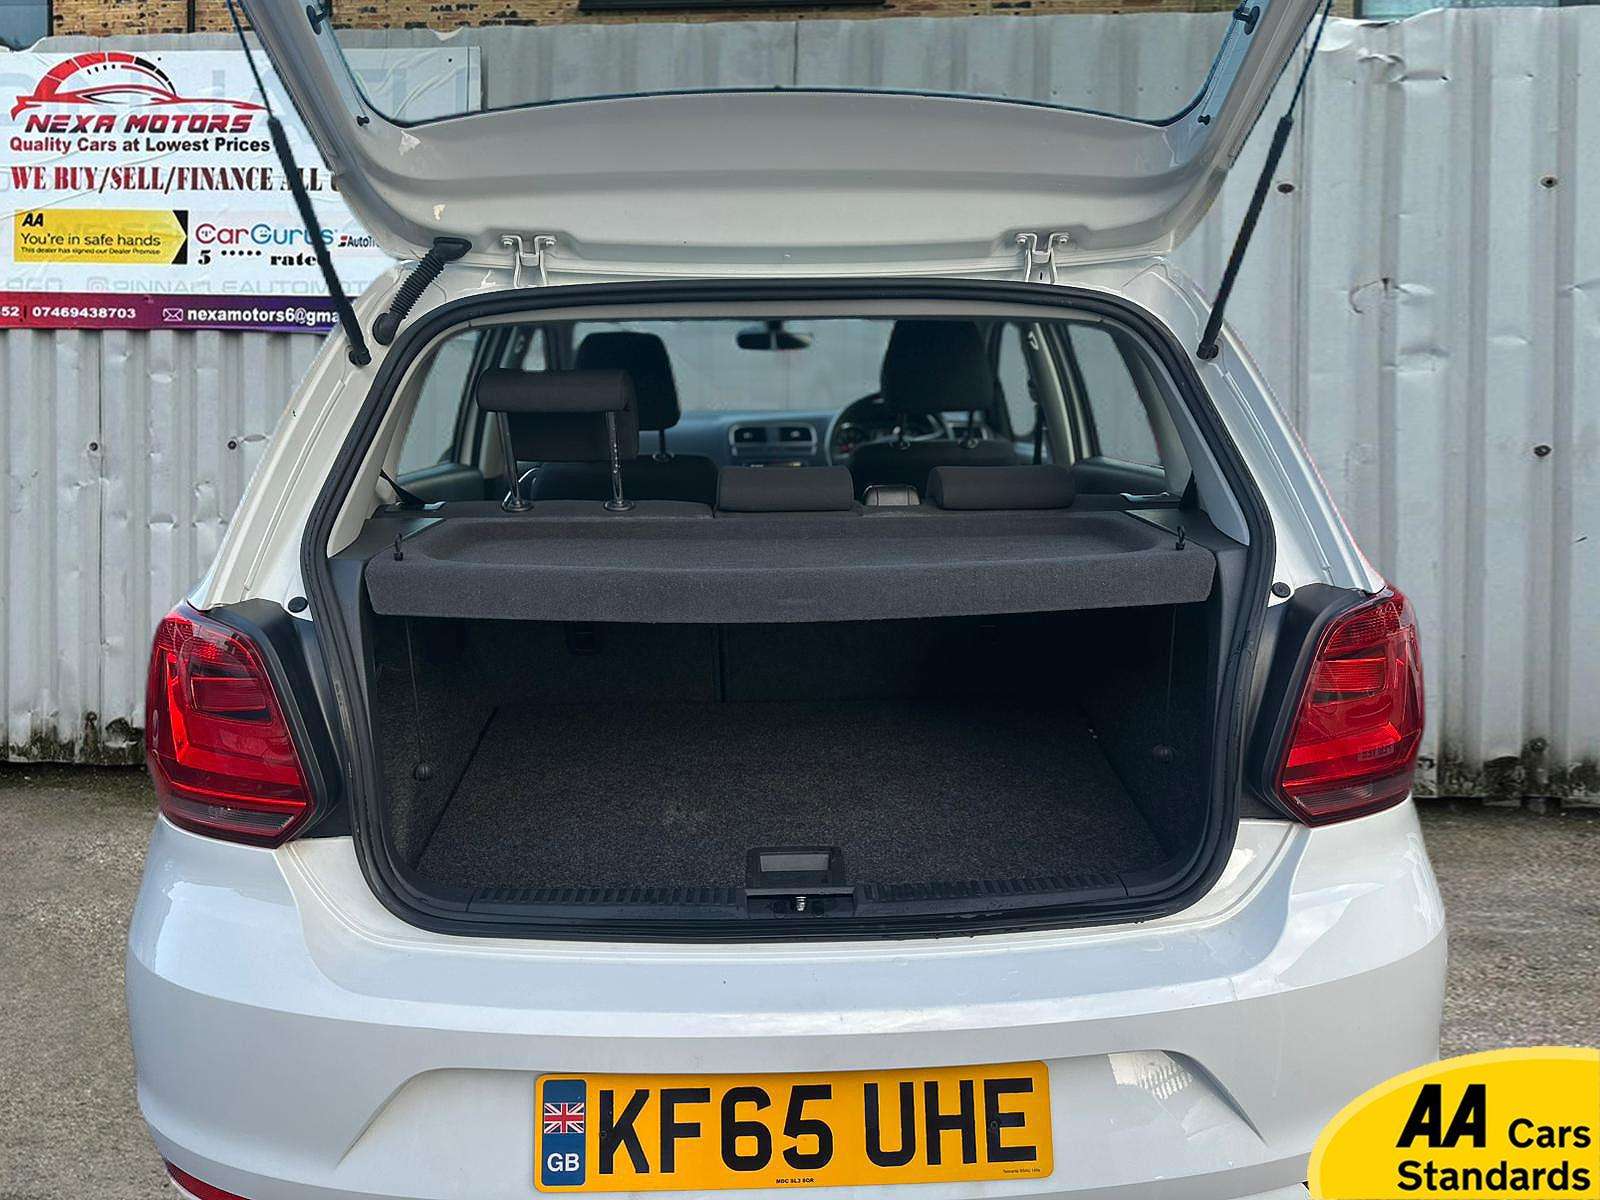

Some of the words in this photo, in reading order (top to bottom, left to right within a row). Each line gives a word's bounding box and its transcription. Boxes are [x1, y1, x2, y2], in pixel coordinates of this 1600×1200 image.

[25, 114, 117, 133] NEXA
[123, 114, 253, 133] MOTORS
[10, 137, 72, 155] Quality
[77, 138, 117, 151] Cars
[122, 137, 140, 151] at
[145, 137, 209, 151] Lowest
[215, 137, 271, 151] Prices
[11, 166, 47, 190] WE
[281, 167, 322, 191] LL
[22, 213, 44, 227] AA
[21, 233, 64, 246] You're
[68, 233, 80, 246] in
[84, 233, 113, 246] safe
[117, 234, 161, 247] hands
[198, 250, 211, 265] 5
[270, 251, 330, 266] rate
[0, 306, 20, 317] 52
[32, 306, 136, 319] 07469438703
[187, 307, 340, 325] nexamotors6@gma
[599, 1084, 833, 1175] KF65
[864, 1077, 1038, 1168] UHE
[546, 1152, 581, 1173] GB
